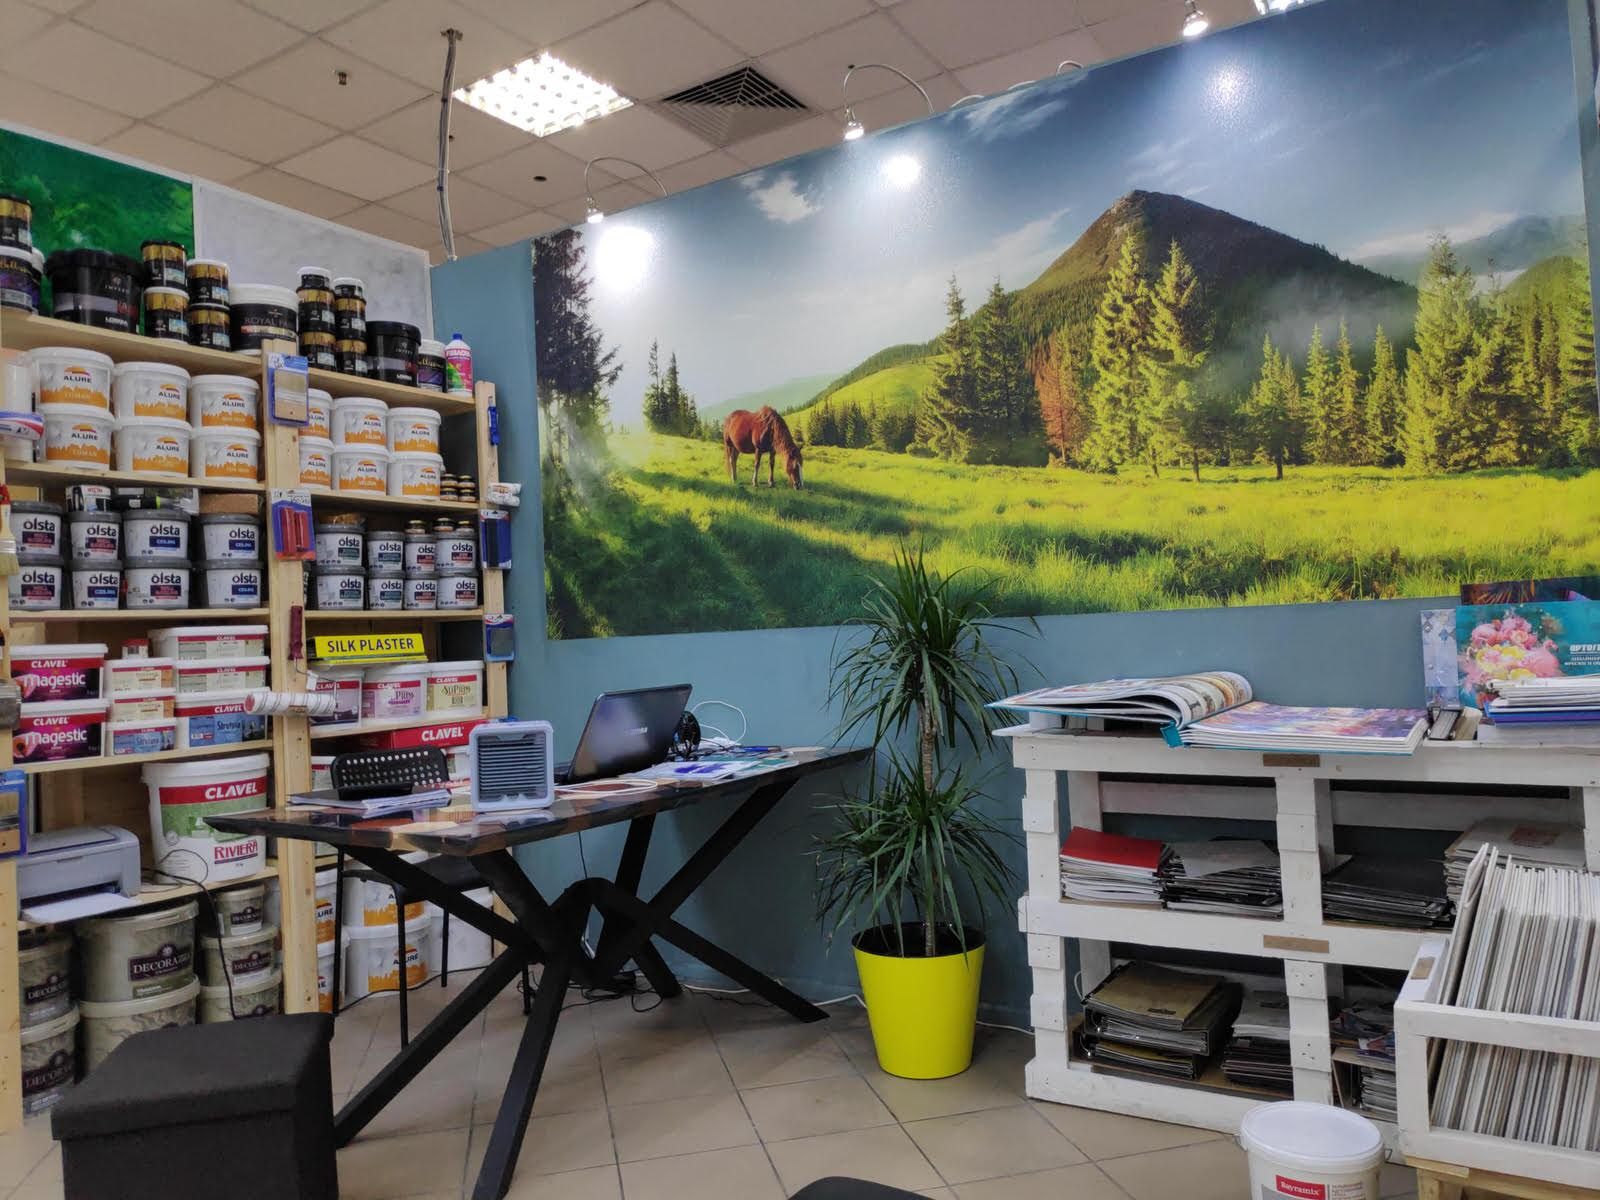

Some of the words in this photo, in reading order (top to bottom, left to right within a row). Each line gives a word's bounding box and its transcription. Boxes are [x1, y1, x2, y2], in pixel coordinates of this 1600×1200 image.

[63, 375, 92, 384] ALURE
[158, 391, 181, 400] ALURE
[71, 432, 98, 440] ALURE
[307, 460, 326, 468] ALURE
[327, 640, 356, 653] SILK
[359, 637, 415, 652] PLASTER
[31, 660, 66, 669] CLAVEL
[22, 672, 86, 690] magestic
[214, 704, 242, 713] CLAVEL
[33, 717, 68, 726] CLAVEL
[23, 728, 88, 747] magestic
[421, 726, 464, 742] CLAVEL
[205, 782, 257, 799] CLAVEL
[214, 840, 258, 859] RIVIERA
[1280, 1180, 1320, 1197] Bayramix
